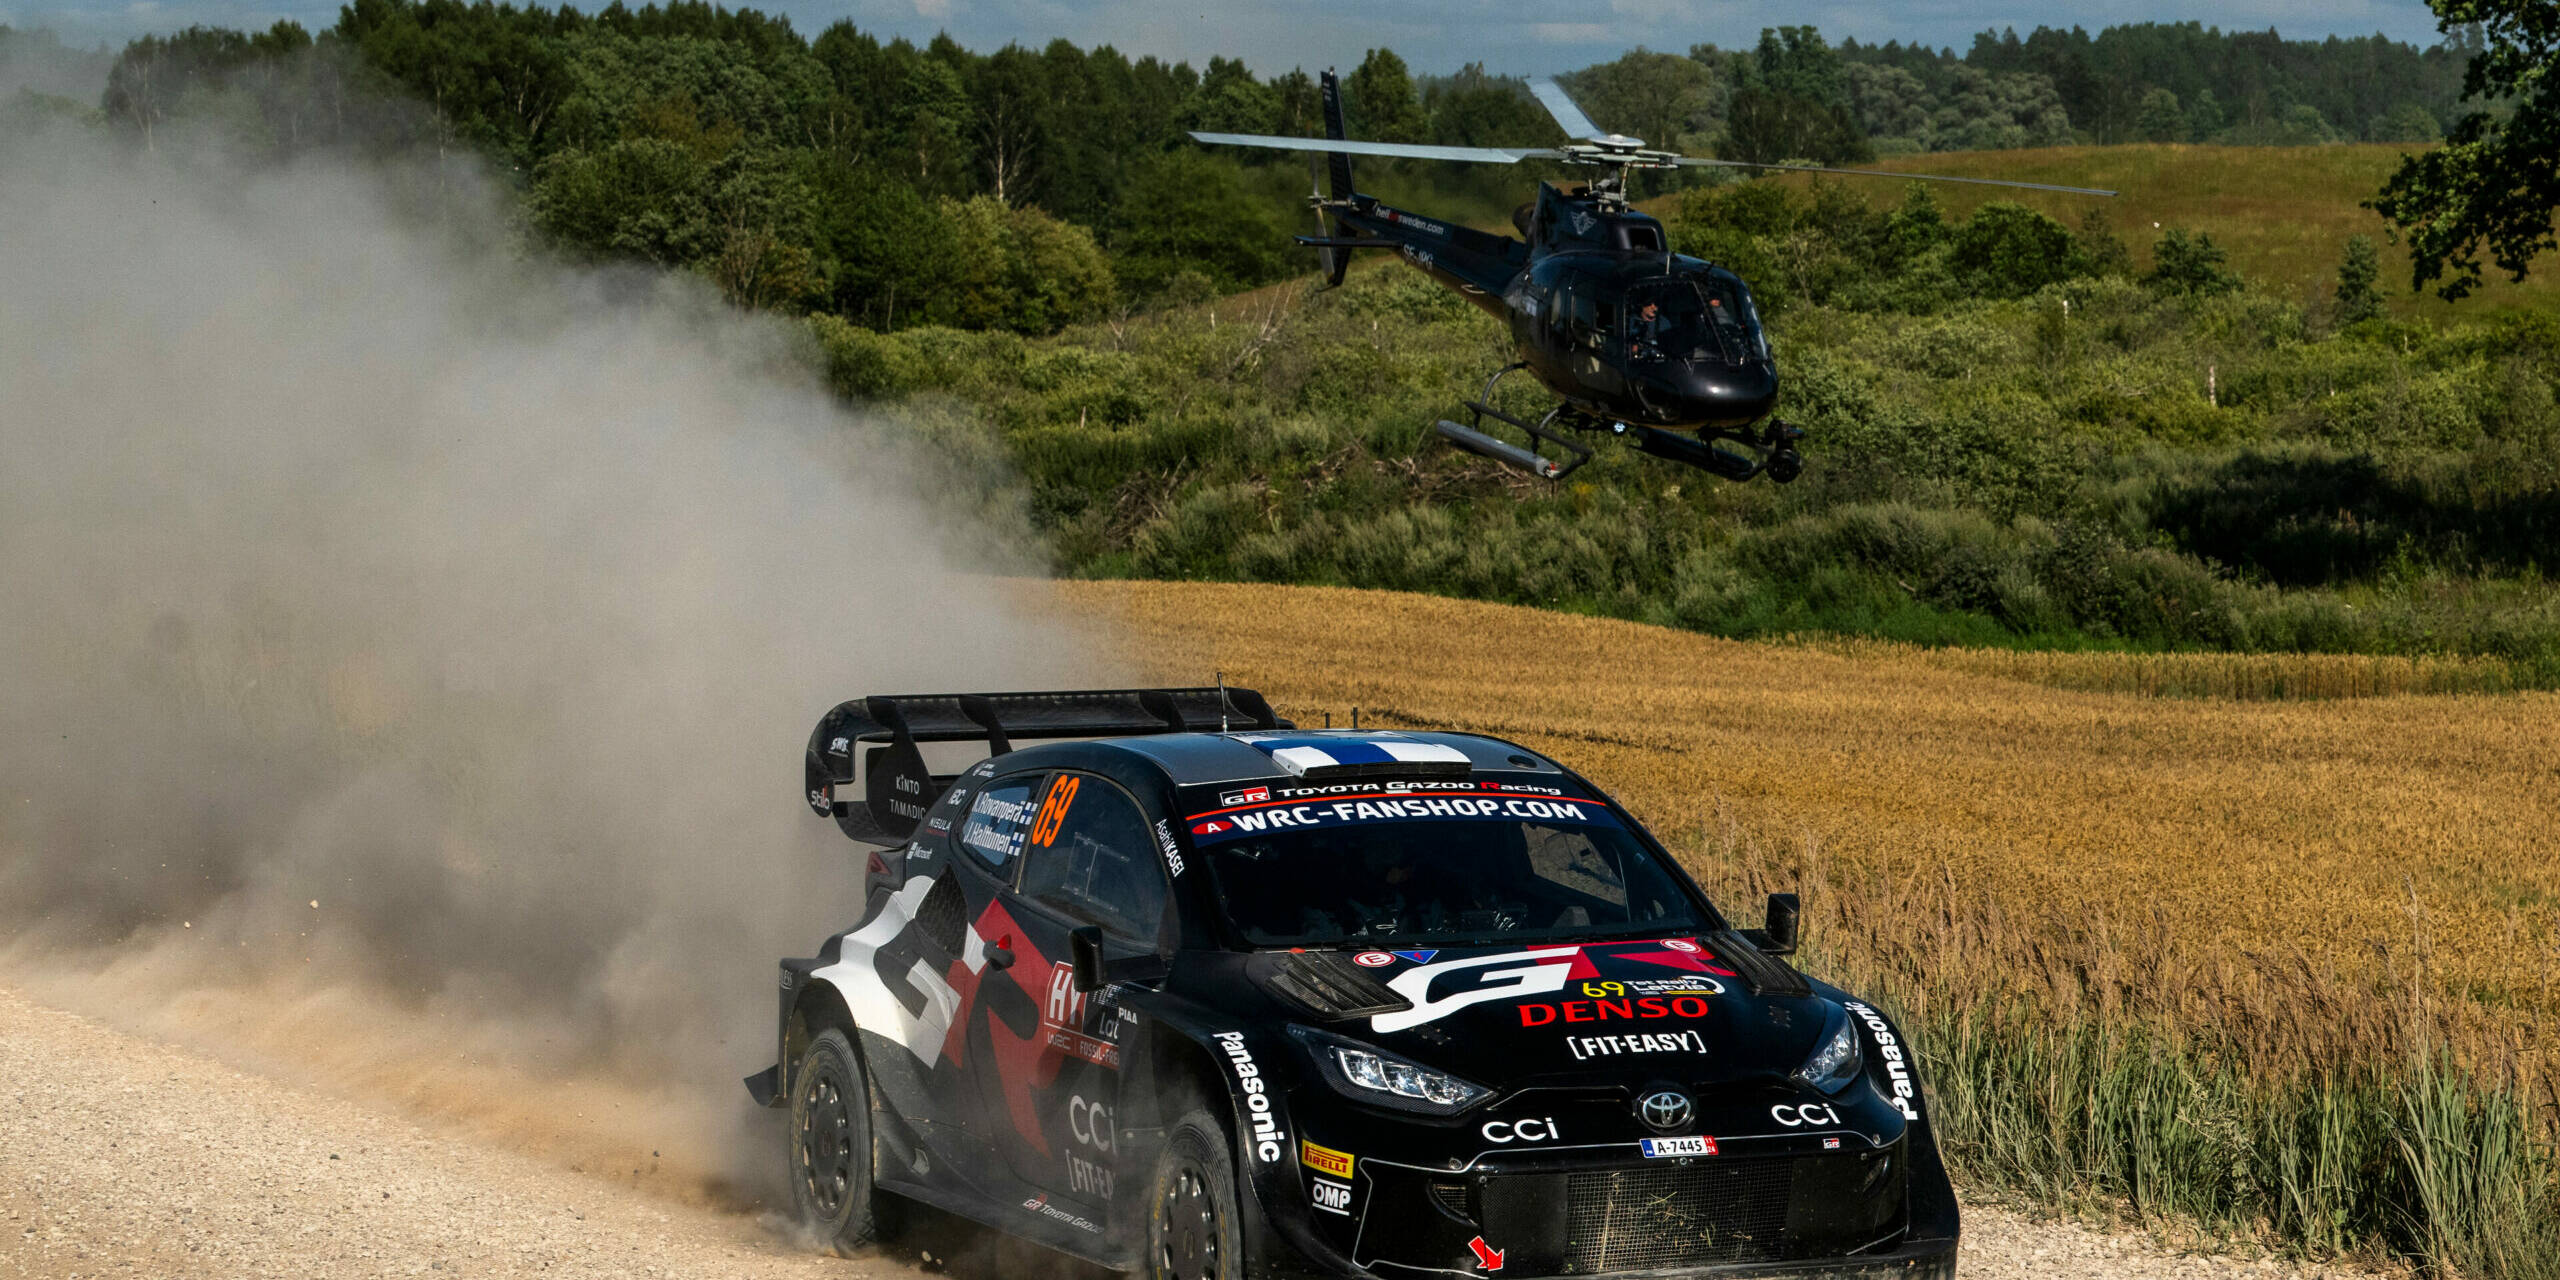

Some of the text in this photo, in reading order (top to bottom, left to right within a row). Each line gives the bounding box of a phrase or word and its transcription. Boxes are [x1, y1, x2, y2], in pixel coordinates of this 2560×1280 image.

[1375, 206, 1444, 235] helisweden.com
[1223, 781, 1562, 806] GR TOYOTA GAZOO Racing
[1032, 774, 1080, 848] 69
[1229, 800, 1587, 832] WRC-FANSHOP.COM
[1583, 981, 1625, 998] 69
[1632, 984, 1708, 992] Latvia
[1118, 1006, 1138, 1025] PIAA
[1517, 997, 1709, 1027] DENSO
[1844, 1001, 1919, 1121] Panasonic
[1212, 1031, 1286, 1163] Panasonic
[1304, 1145, 1350, 1175] PIRELLI
[1657, 1140, 1703, 1154] A-7445
[1022, 1193, 1047, 1211] GR
[1040, 1204, 1074, 1223] TOYOTA
[1313, 1183, 1351, 1209] OMP
